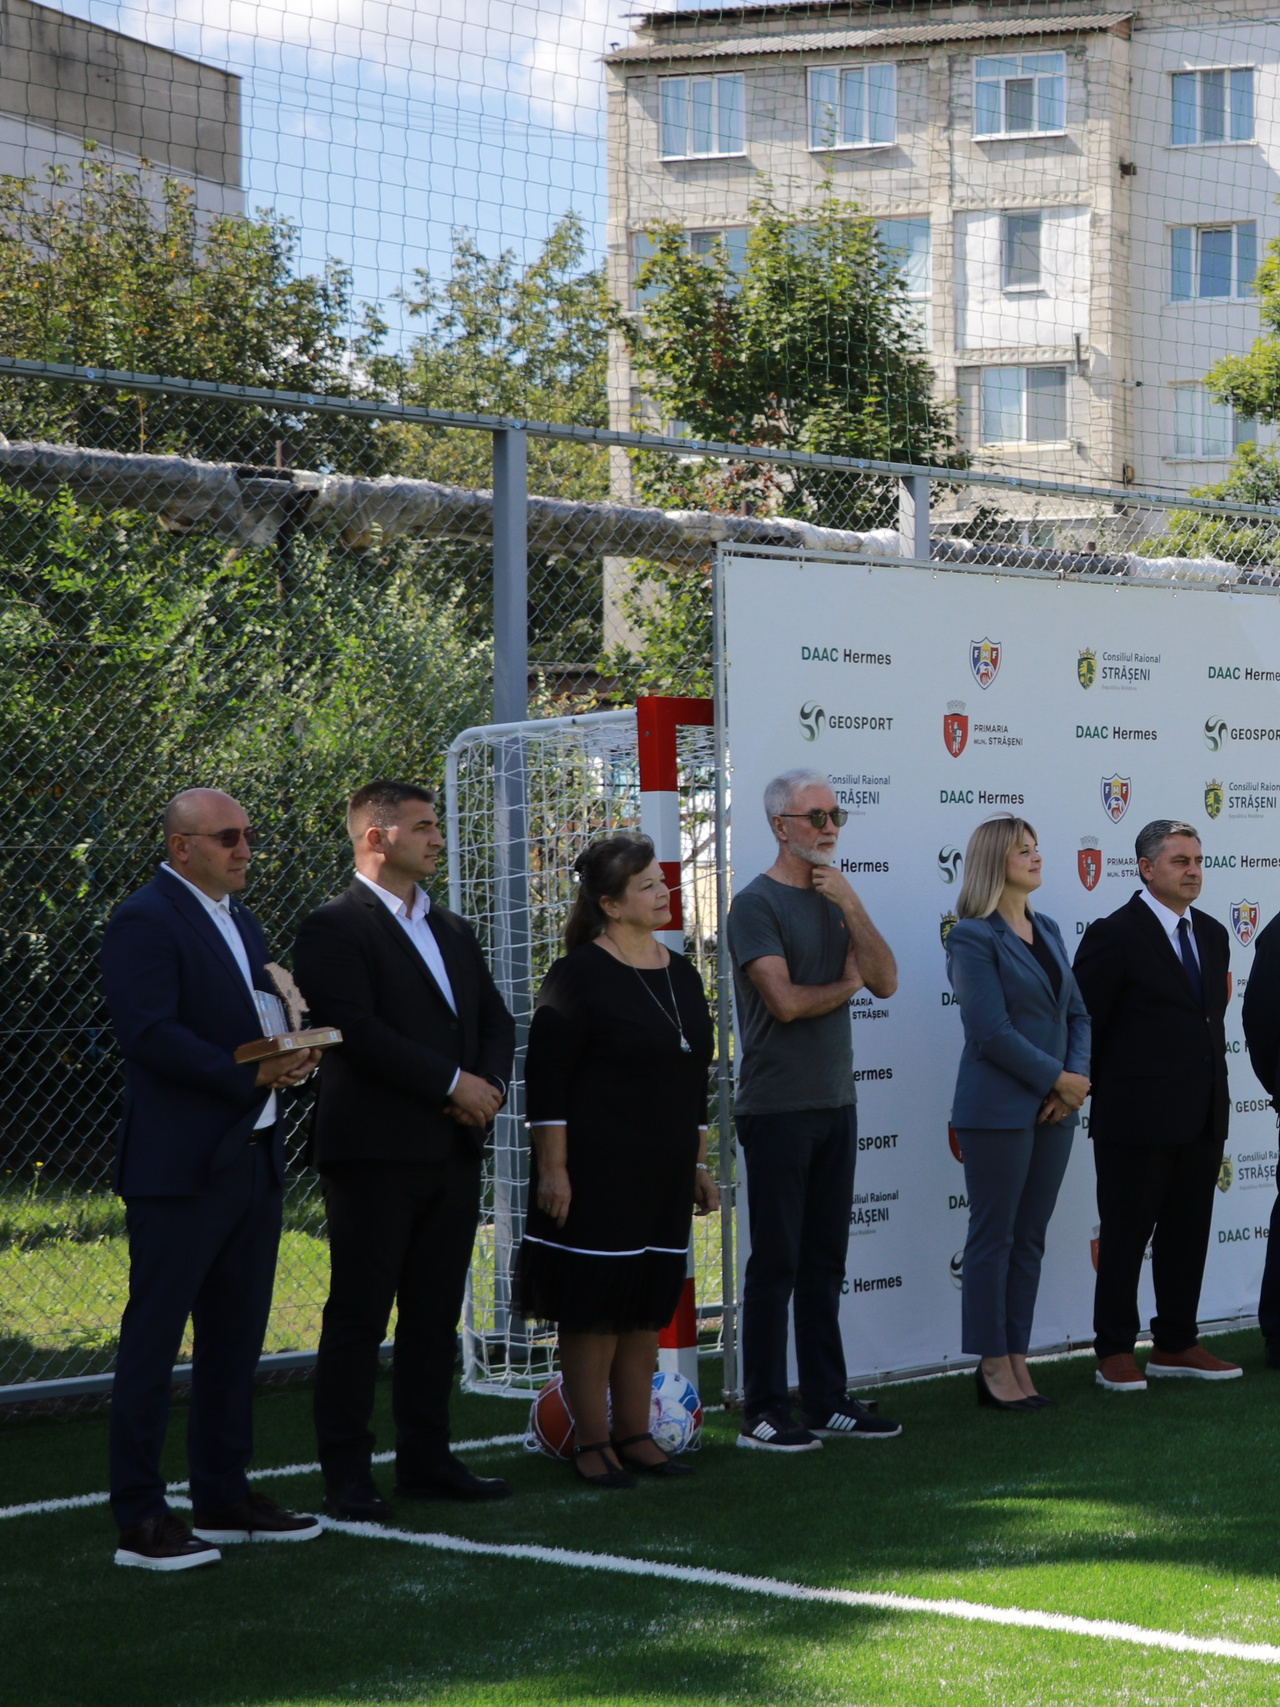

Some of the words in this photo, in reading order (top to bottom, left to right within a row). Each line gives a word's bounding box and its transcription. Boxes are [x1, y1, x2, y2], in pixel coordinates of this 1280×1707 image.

[801, 646, 839, 662] DAAC
[843, 649, 892, 665] Hermes
[1102, 651, 1134, 662] Consiliul
[1134, 653, 1161, 663] Raional
[1208, 666, 1241, 680] DAAC
[828, 715, 894, 731] GEOSPORT
[1076, 725, 1109, 739] DAAC
[1112, 727, 1158, 741] Hermes
[861, 775, 891, 785] Raional
[1228, 781, 1260, 791] Consiliul
[834, 788, 880, 808] TRĂȘENI
[940, 790, 974, 804] DAAC
[978, 791, 1024, 805] Hermes
[840, 858, 889, 873] Hermes
[1204, 855, 1236, 868] DAAC
[853, 1067, 893, 1082] ermes
[858, 1134, 899, 1151] SPORT
[870, 1189, 899, 1202] Raional
[850, 1207, 889, 1227] RĂȘENI
[1218, 1227, 1251, 1243] DAAC
[853, 1275, 902, 1293] Hermes
